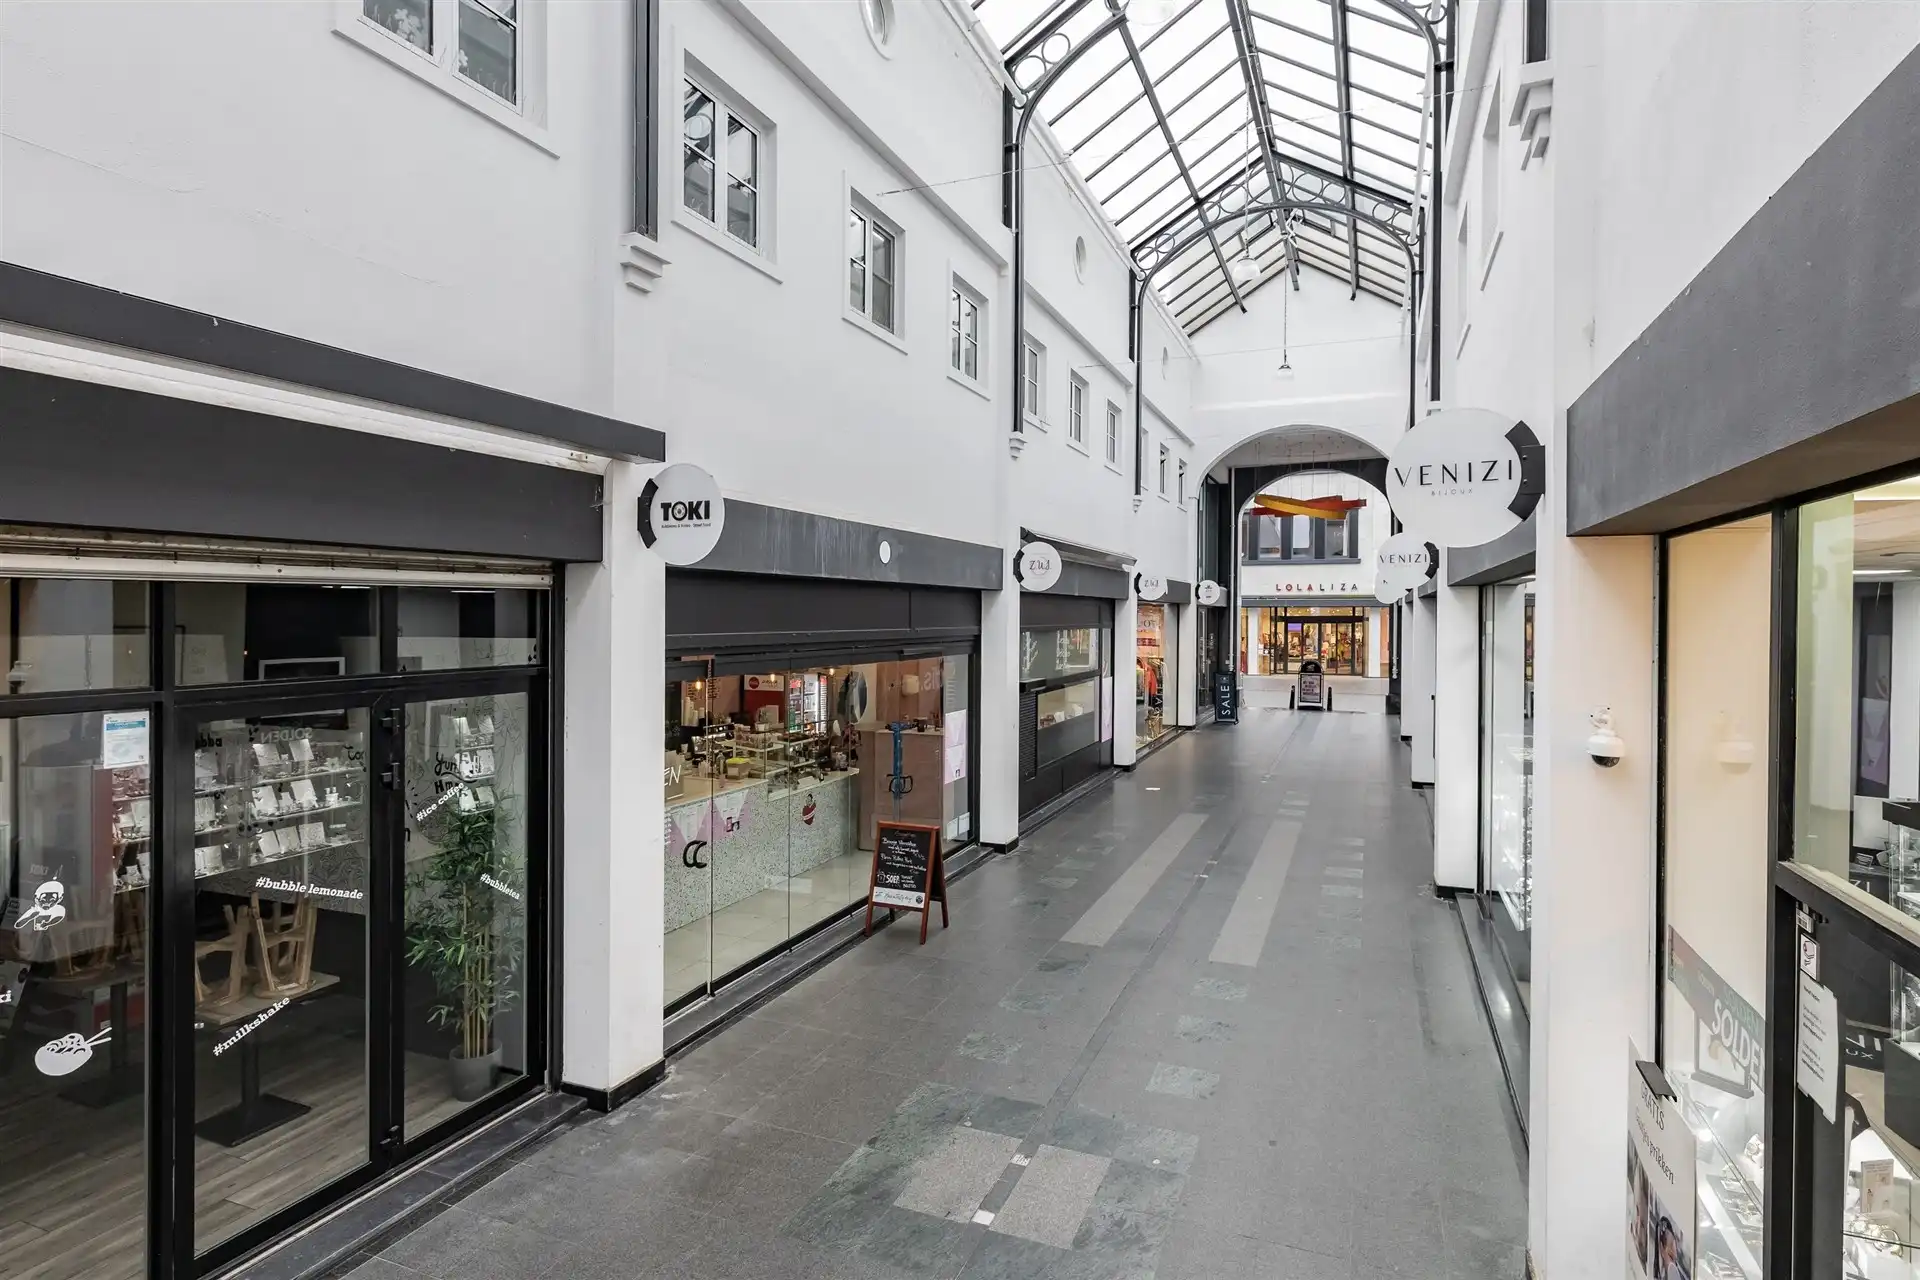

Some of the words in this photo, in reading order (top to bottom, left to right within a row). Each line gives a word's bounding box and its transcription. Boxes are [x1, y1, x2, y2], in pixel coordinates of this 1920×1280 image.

[1394, 459, 1512, 488] VENIZI
[1431, 488, 1473, 496] BIJOUX
[661, 500, 711, 522] TOKI
[1379, 553, 1428, 564] VENIZI
[1275, 583, 1359, 592] LOLALIZA
[1220, 684, 1231, 716] SALE
[416, 803, 438, 822] #ice
[438, 782, 465, 805] coffee
[255, 876, 307, 893] #bubble
[308, 883, 364, 900] lemonade
[480, 873, 521, 900] #bubbletea
[212, 997, 290, 1056] #milkshake
